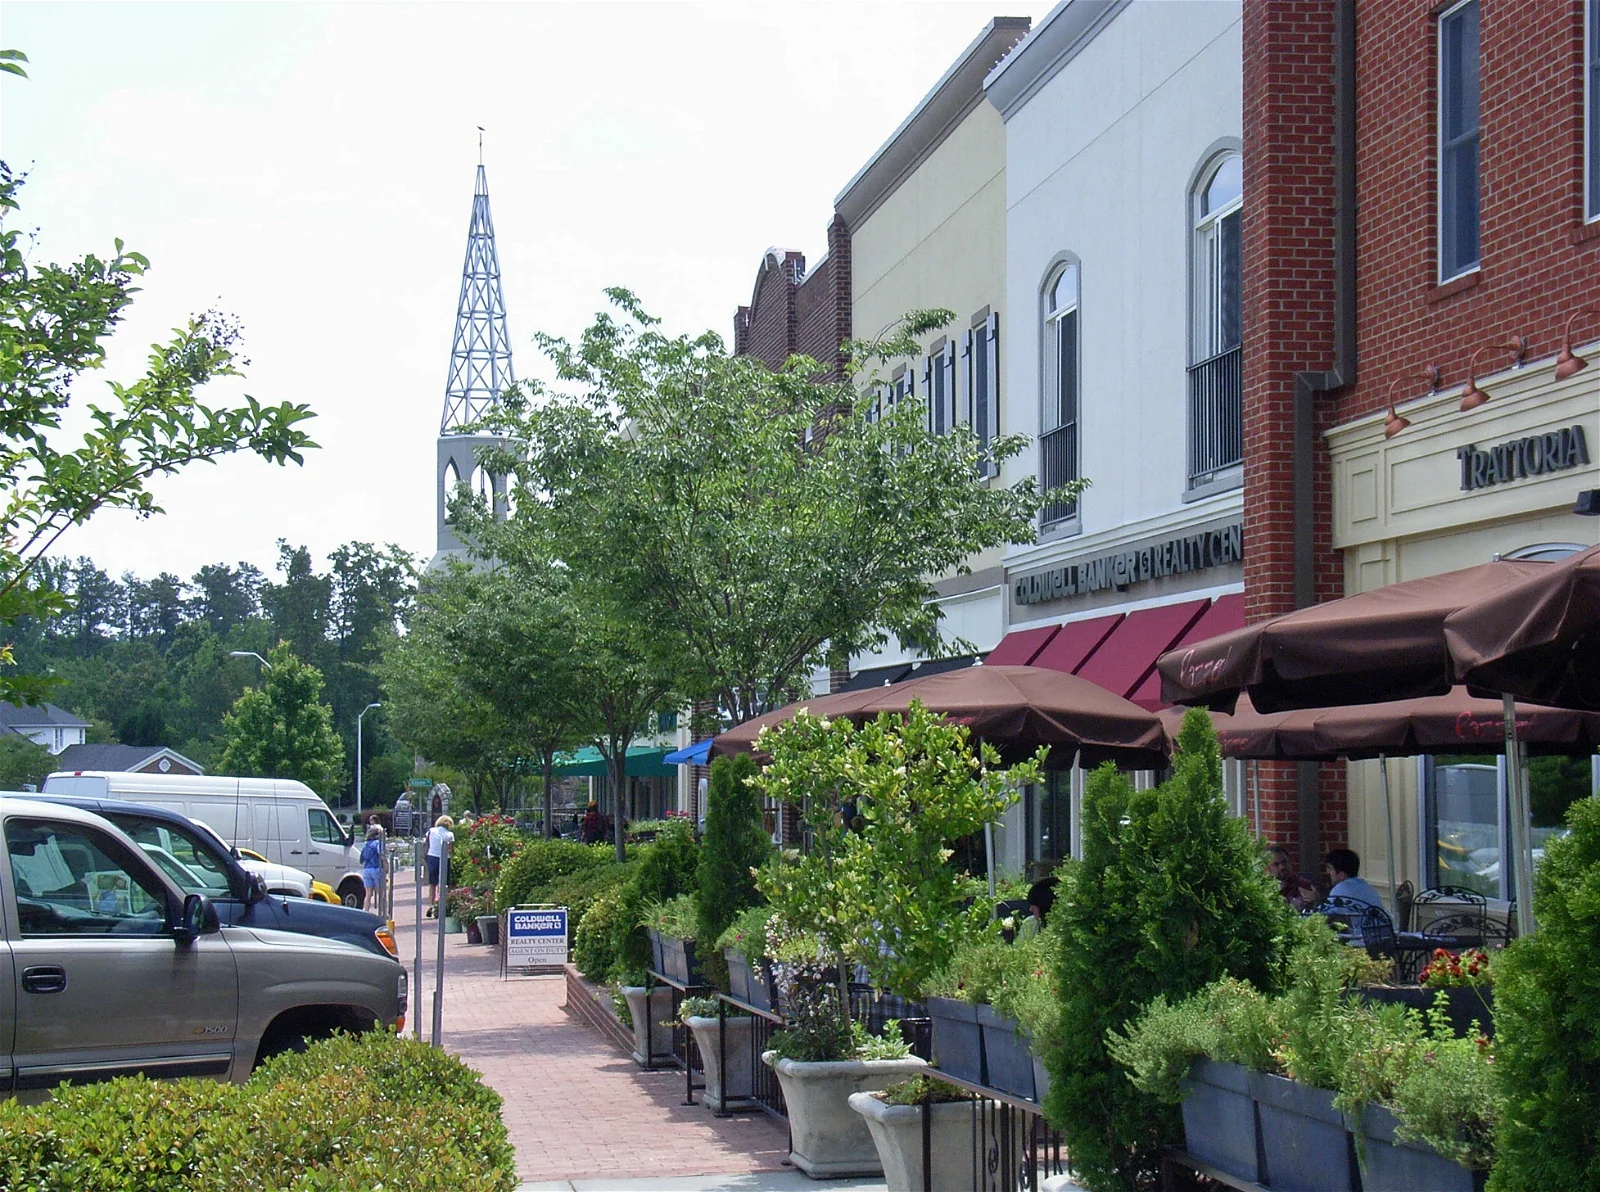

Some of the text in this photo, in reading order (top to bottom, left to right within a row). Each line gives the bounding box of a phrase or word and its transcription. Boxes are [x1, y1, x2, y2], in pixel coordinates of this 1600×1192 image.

[1457, 424, 1590, 490] TRATTORIA
[1152, 533, 1207, 579] REALTY
[1209, 522, 1244, 566] CEN
[514, 922, 553, 930] BANKER
[204, 1026, 228, 1034] 1500
